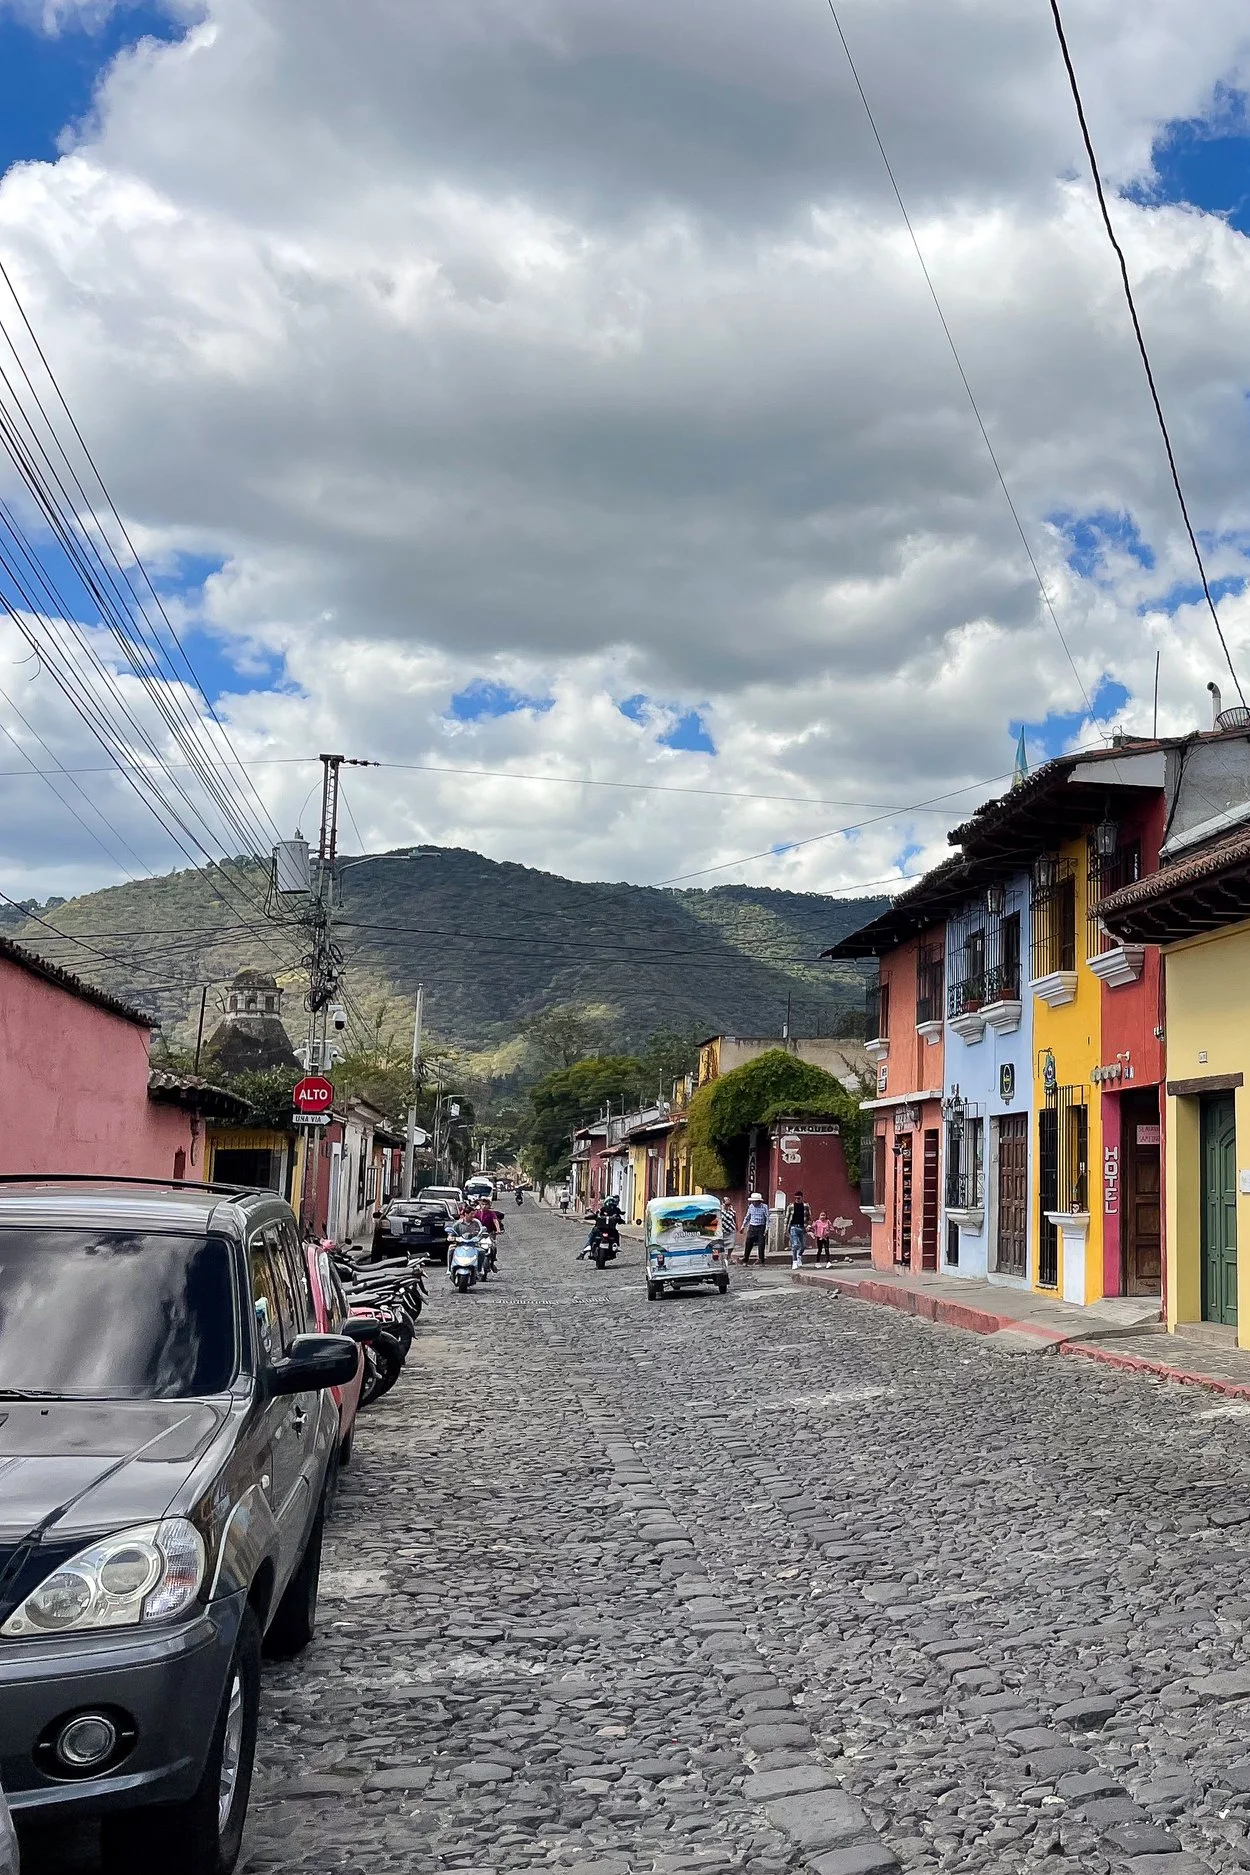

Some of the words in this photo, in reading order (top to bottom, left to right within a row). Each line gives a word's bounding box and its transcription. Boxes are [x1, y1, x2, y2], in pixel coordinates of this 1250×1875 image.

[298, 1088, 328, 1100] ALTO
[785, 1125, 834, 1133] PARQUEO
[1104, 1146, 1119, 1214] HOTEL
